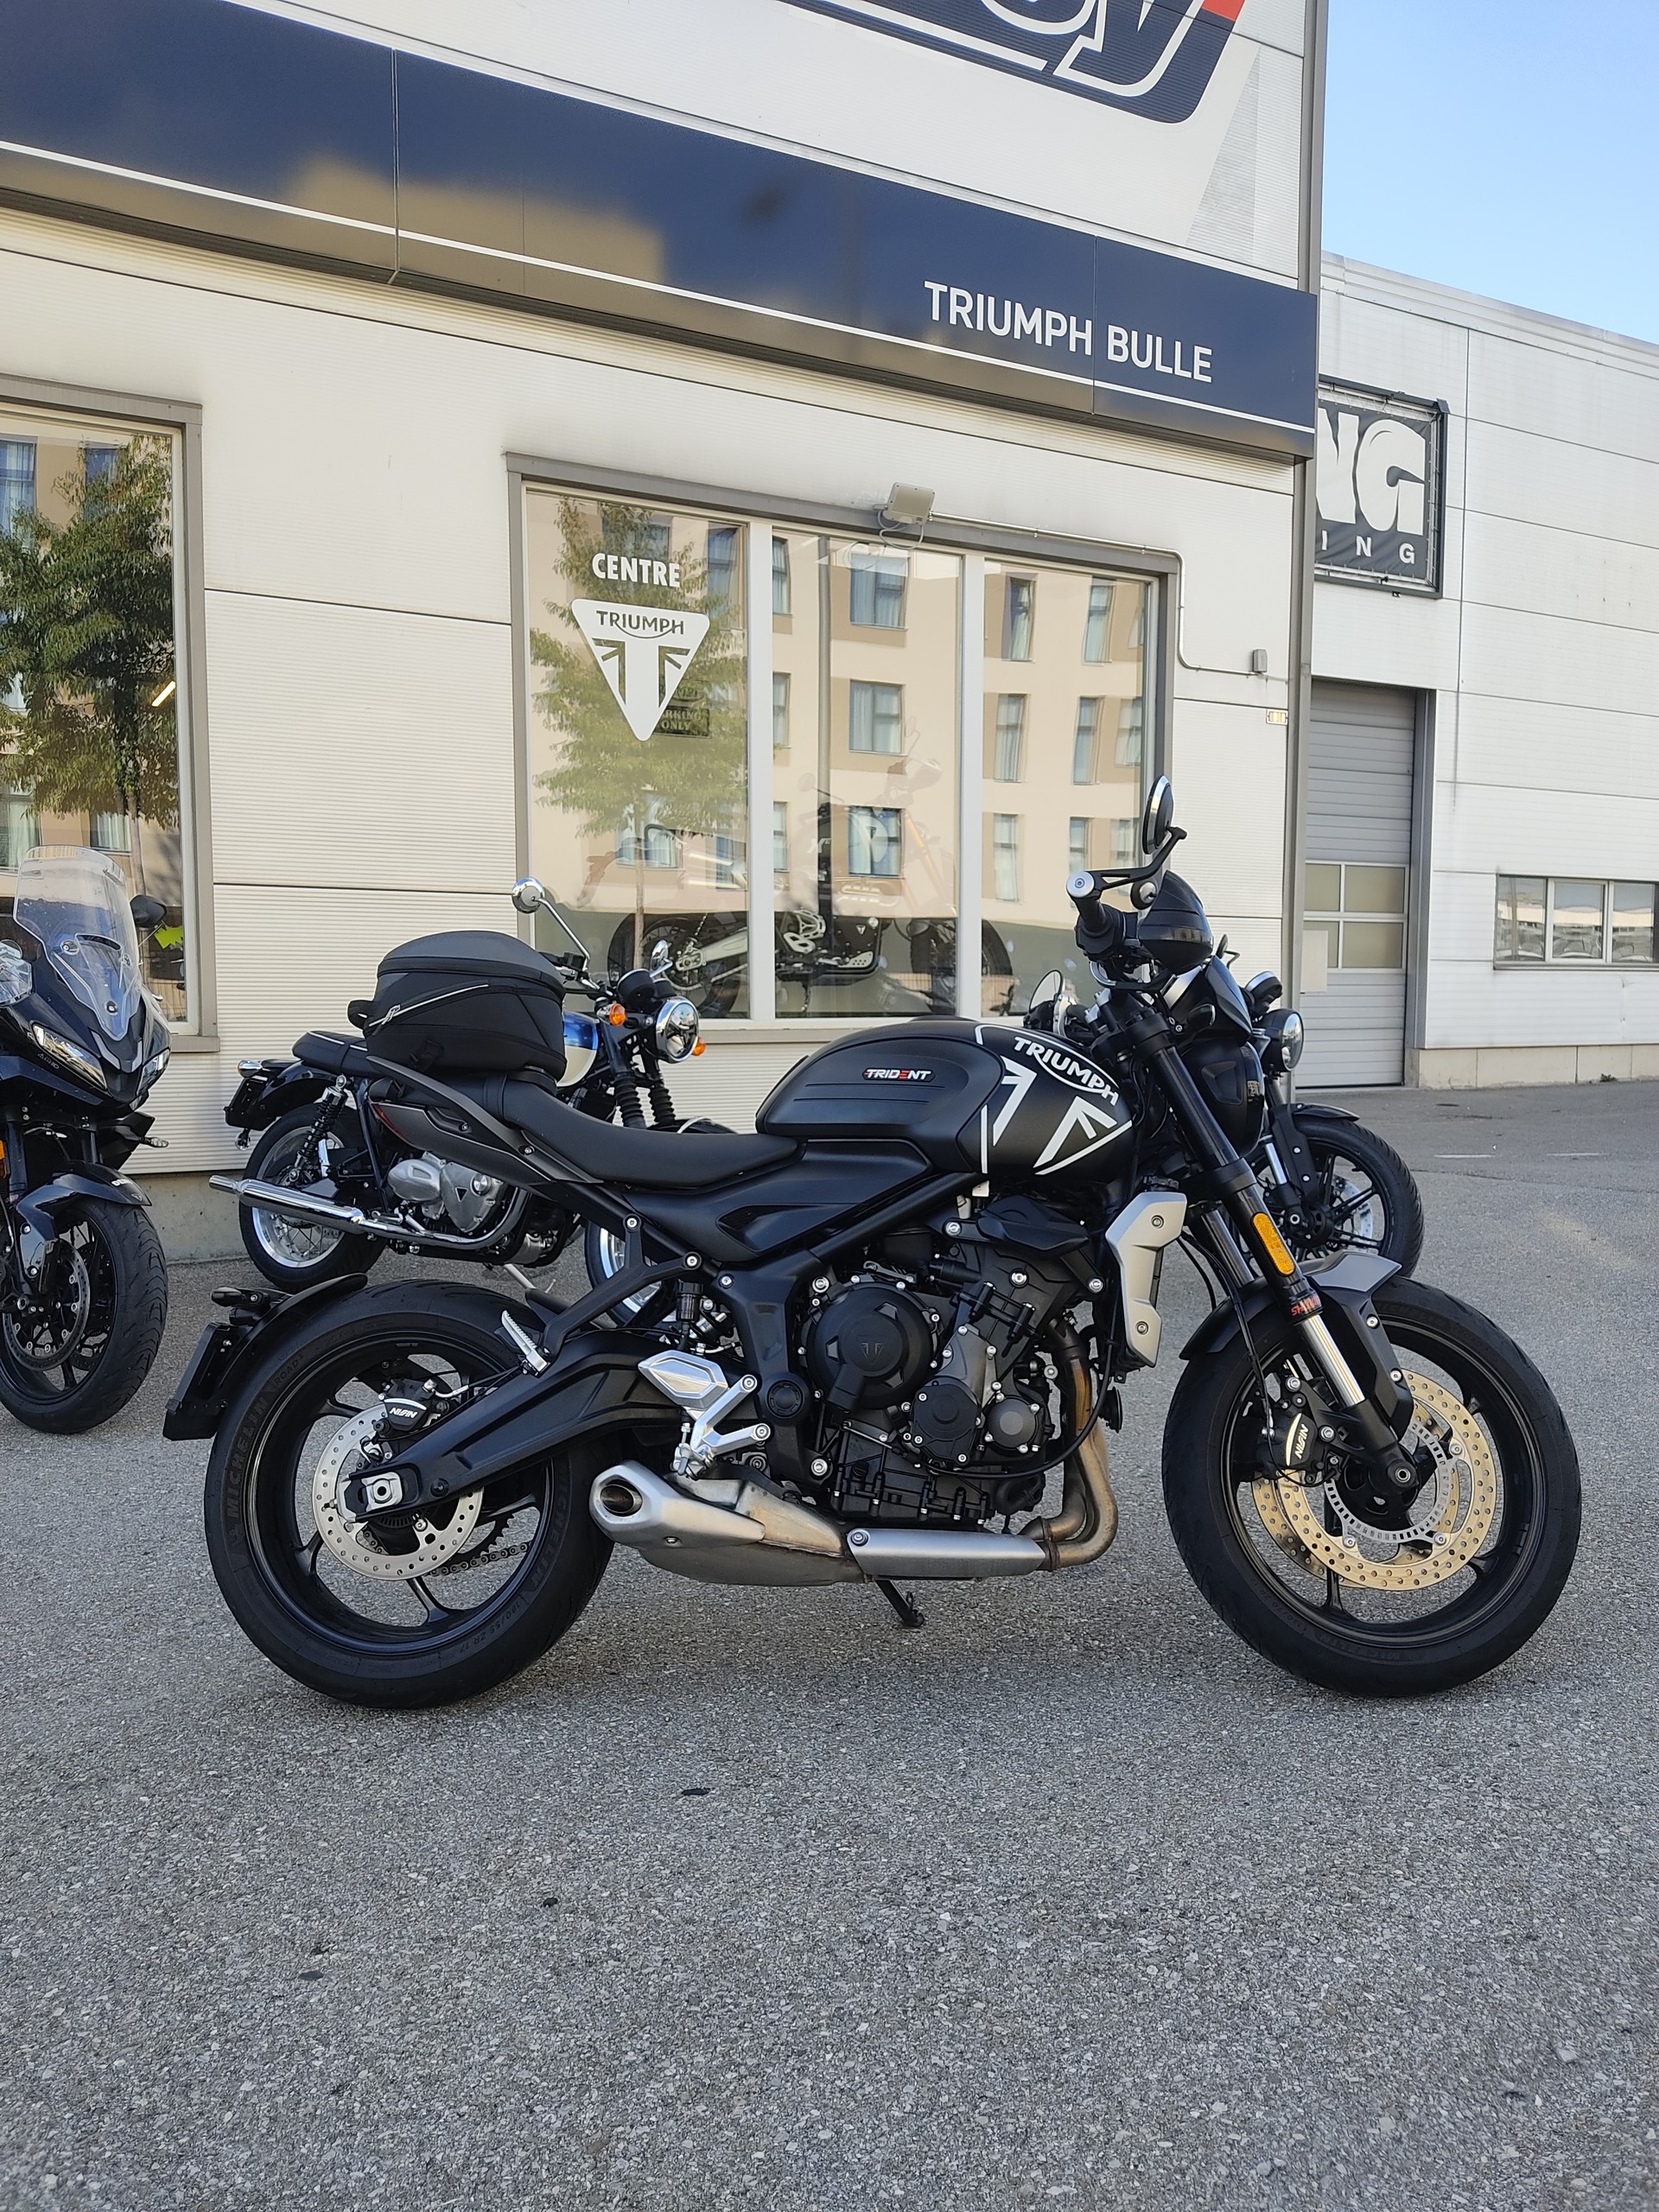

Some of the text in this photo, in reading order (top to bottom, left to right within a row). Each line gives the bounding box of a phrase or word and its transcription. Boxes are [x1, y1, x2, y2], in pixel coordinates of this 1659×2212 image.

[924, 280, 1213, 384] TRIUMPH BULLE
[591, 552, 681, 588] CENTRE
[595, 610, 684, 638] TRIUMPH
[661, 720, 692, 731] ONLY
[662, 709, 702, 721] RKING
[864, 1068, 932, 1081] TRIDENT
[1014, 1036, 1120, 1107] TRIUMPH
